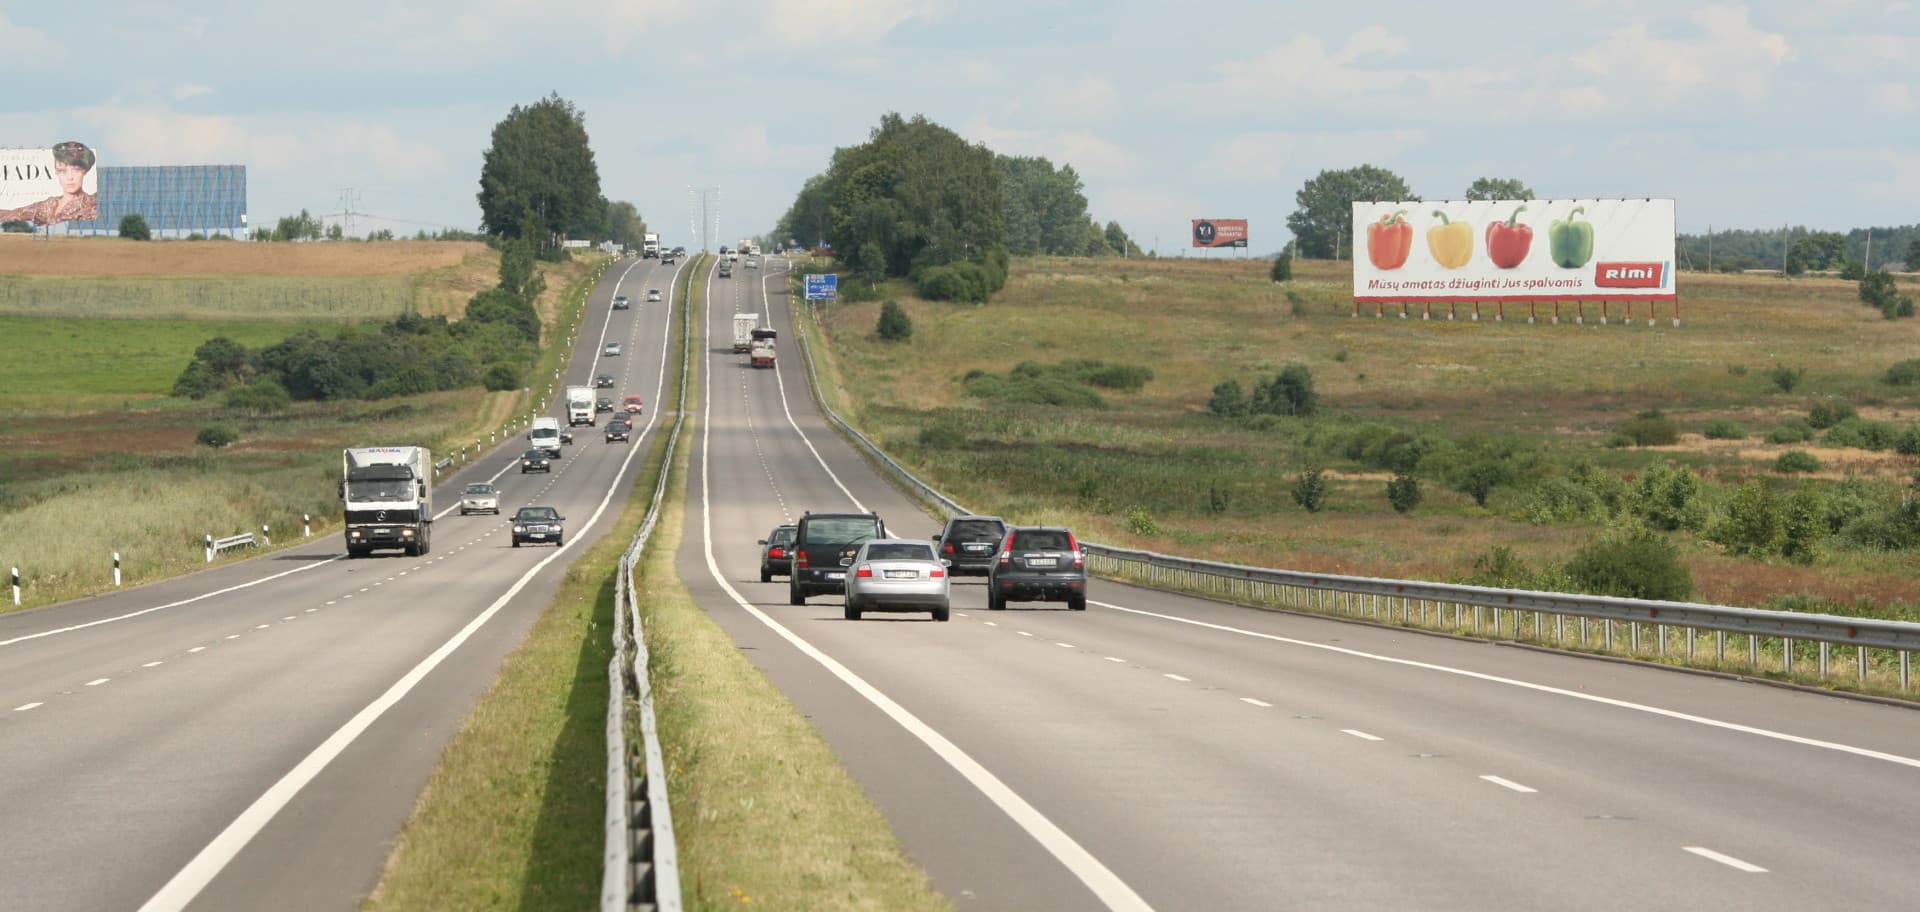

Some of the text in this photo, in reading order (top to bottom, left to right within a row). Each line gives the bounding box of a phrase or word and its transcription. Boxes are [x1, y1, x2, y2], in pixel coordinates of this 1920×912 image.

[1402, 280, 1446, 289] amatas
[1448, 278, 1500, 291] džiuginti
[1503, 278, 1521, 289] Jus
[1523, 277, 1583, 290] spalvomis
